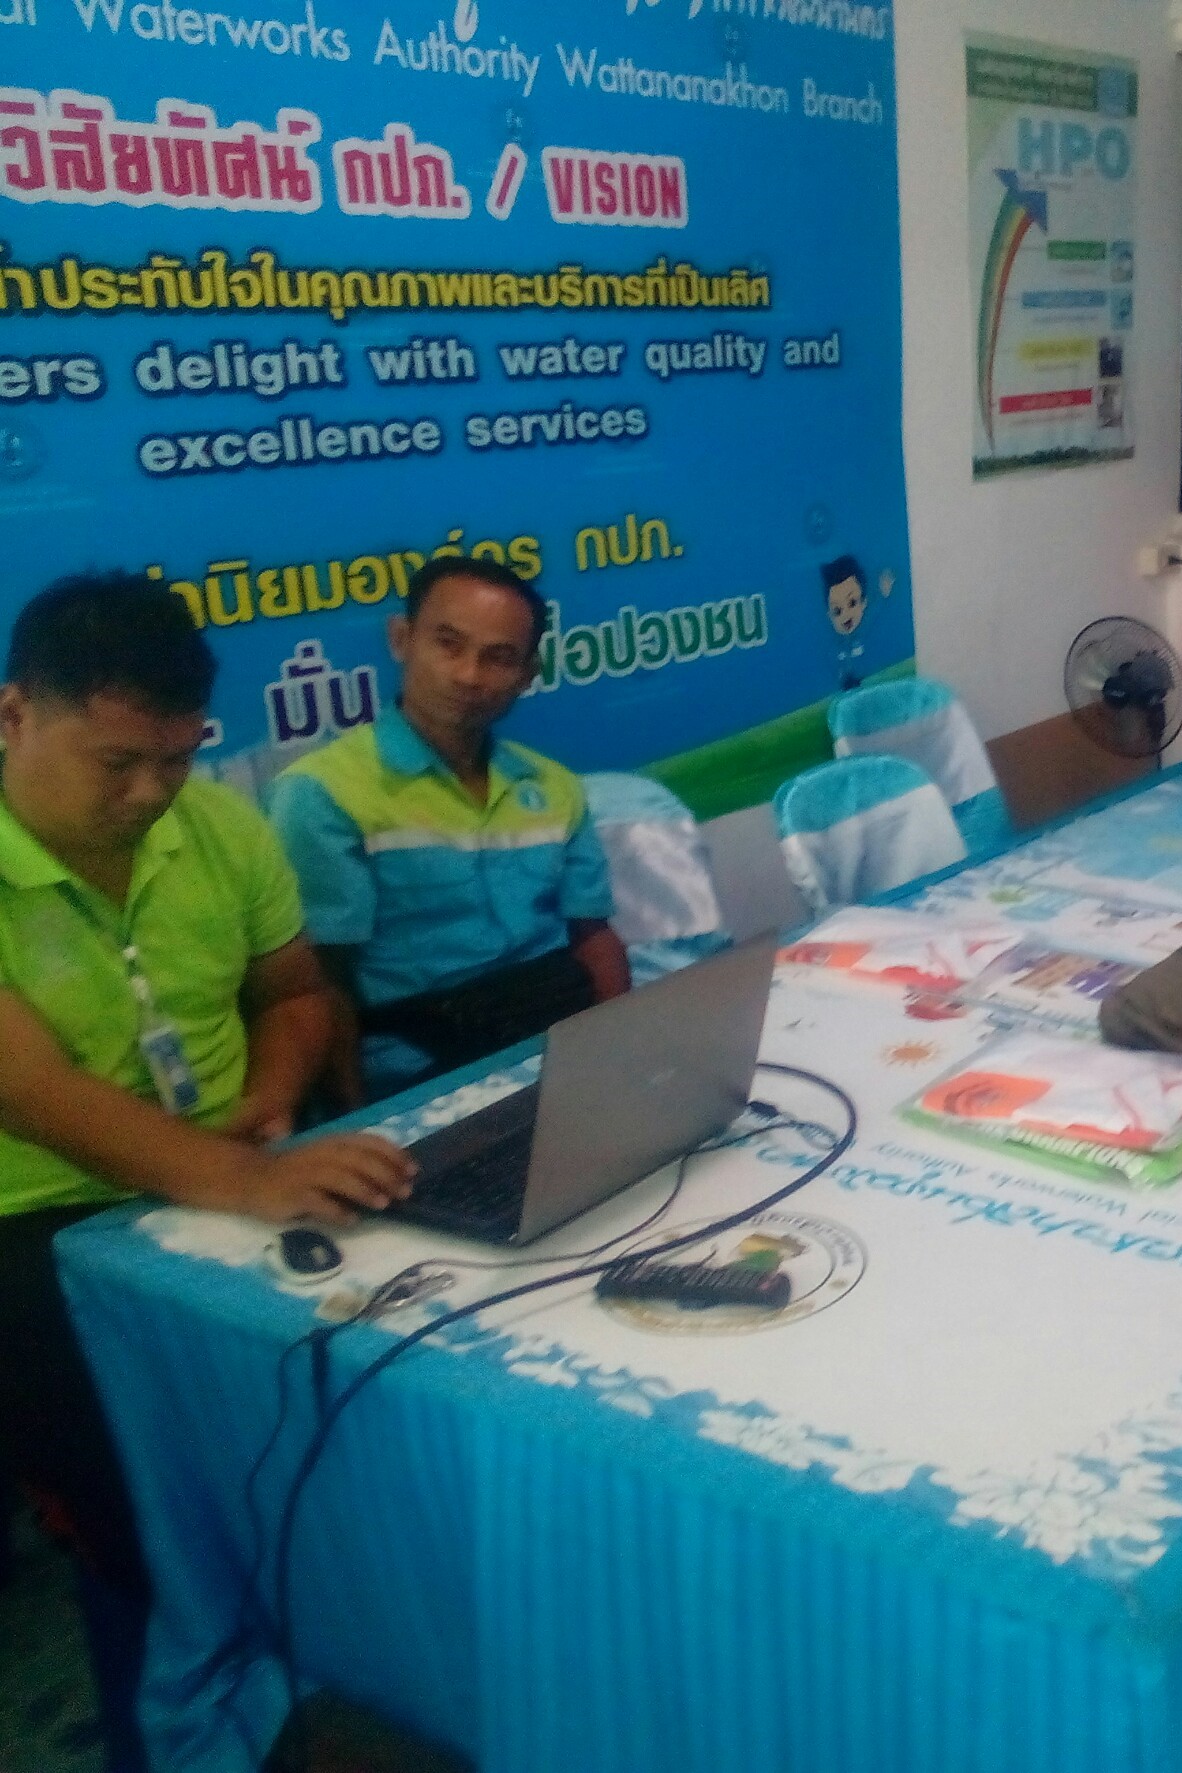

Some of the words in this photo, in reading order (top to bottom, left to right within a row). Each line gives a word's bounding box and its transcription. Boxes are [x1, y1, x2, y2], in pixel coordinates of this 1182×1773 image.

[373, 16, 541, 97] Authority
[555, 43, 789, 114] Wattananakhon
[803, 77, 883, 125] Branch
[1018, 116, 1131, 181] HPO
[550, 157, 682, 219] VISION
[136, 343, 342, 395] delight
[368, 339, 476, 380] with
[500, 338, 626, 376] water
[645, 332, 766, 376] quality
[784, 333, 839, 365] and
[140, 416, 441, 473] excellence
[466, 404, 647, 447] services
[987, 1168, 1128, 1217] Waterworks
